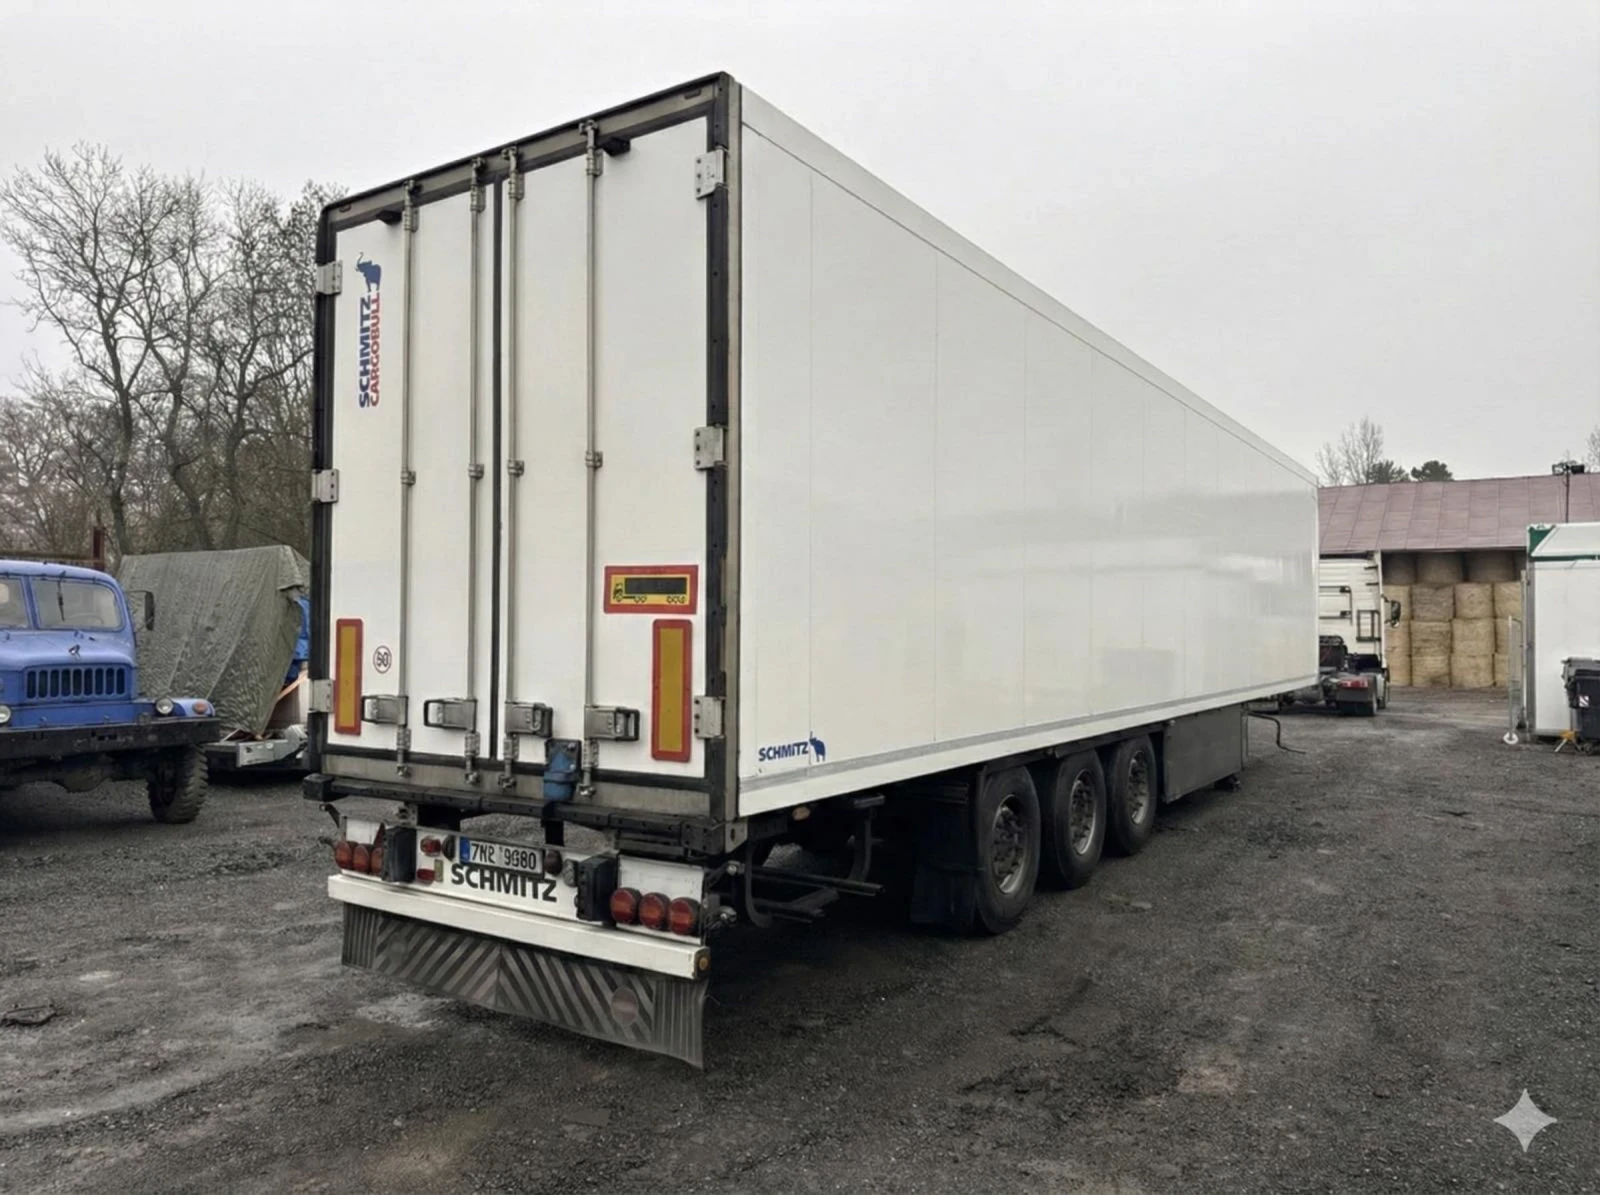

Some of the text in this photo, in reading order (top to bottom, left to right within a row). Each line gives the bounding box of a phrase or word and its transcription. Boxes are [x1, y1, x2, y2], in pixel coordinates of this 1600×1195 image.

[359, 295, 371, 408] SCHMITZ
[370, 292, 380, 407] CARGOBULL
[758, 741, 809, 762] SCHMITZ
[451, 864, 557, 902] SCHMITZ
